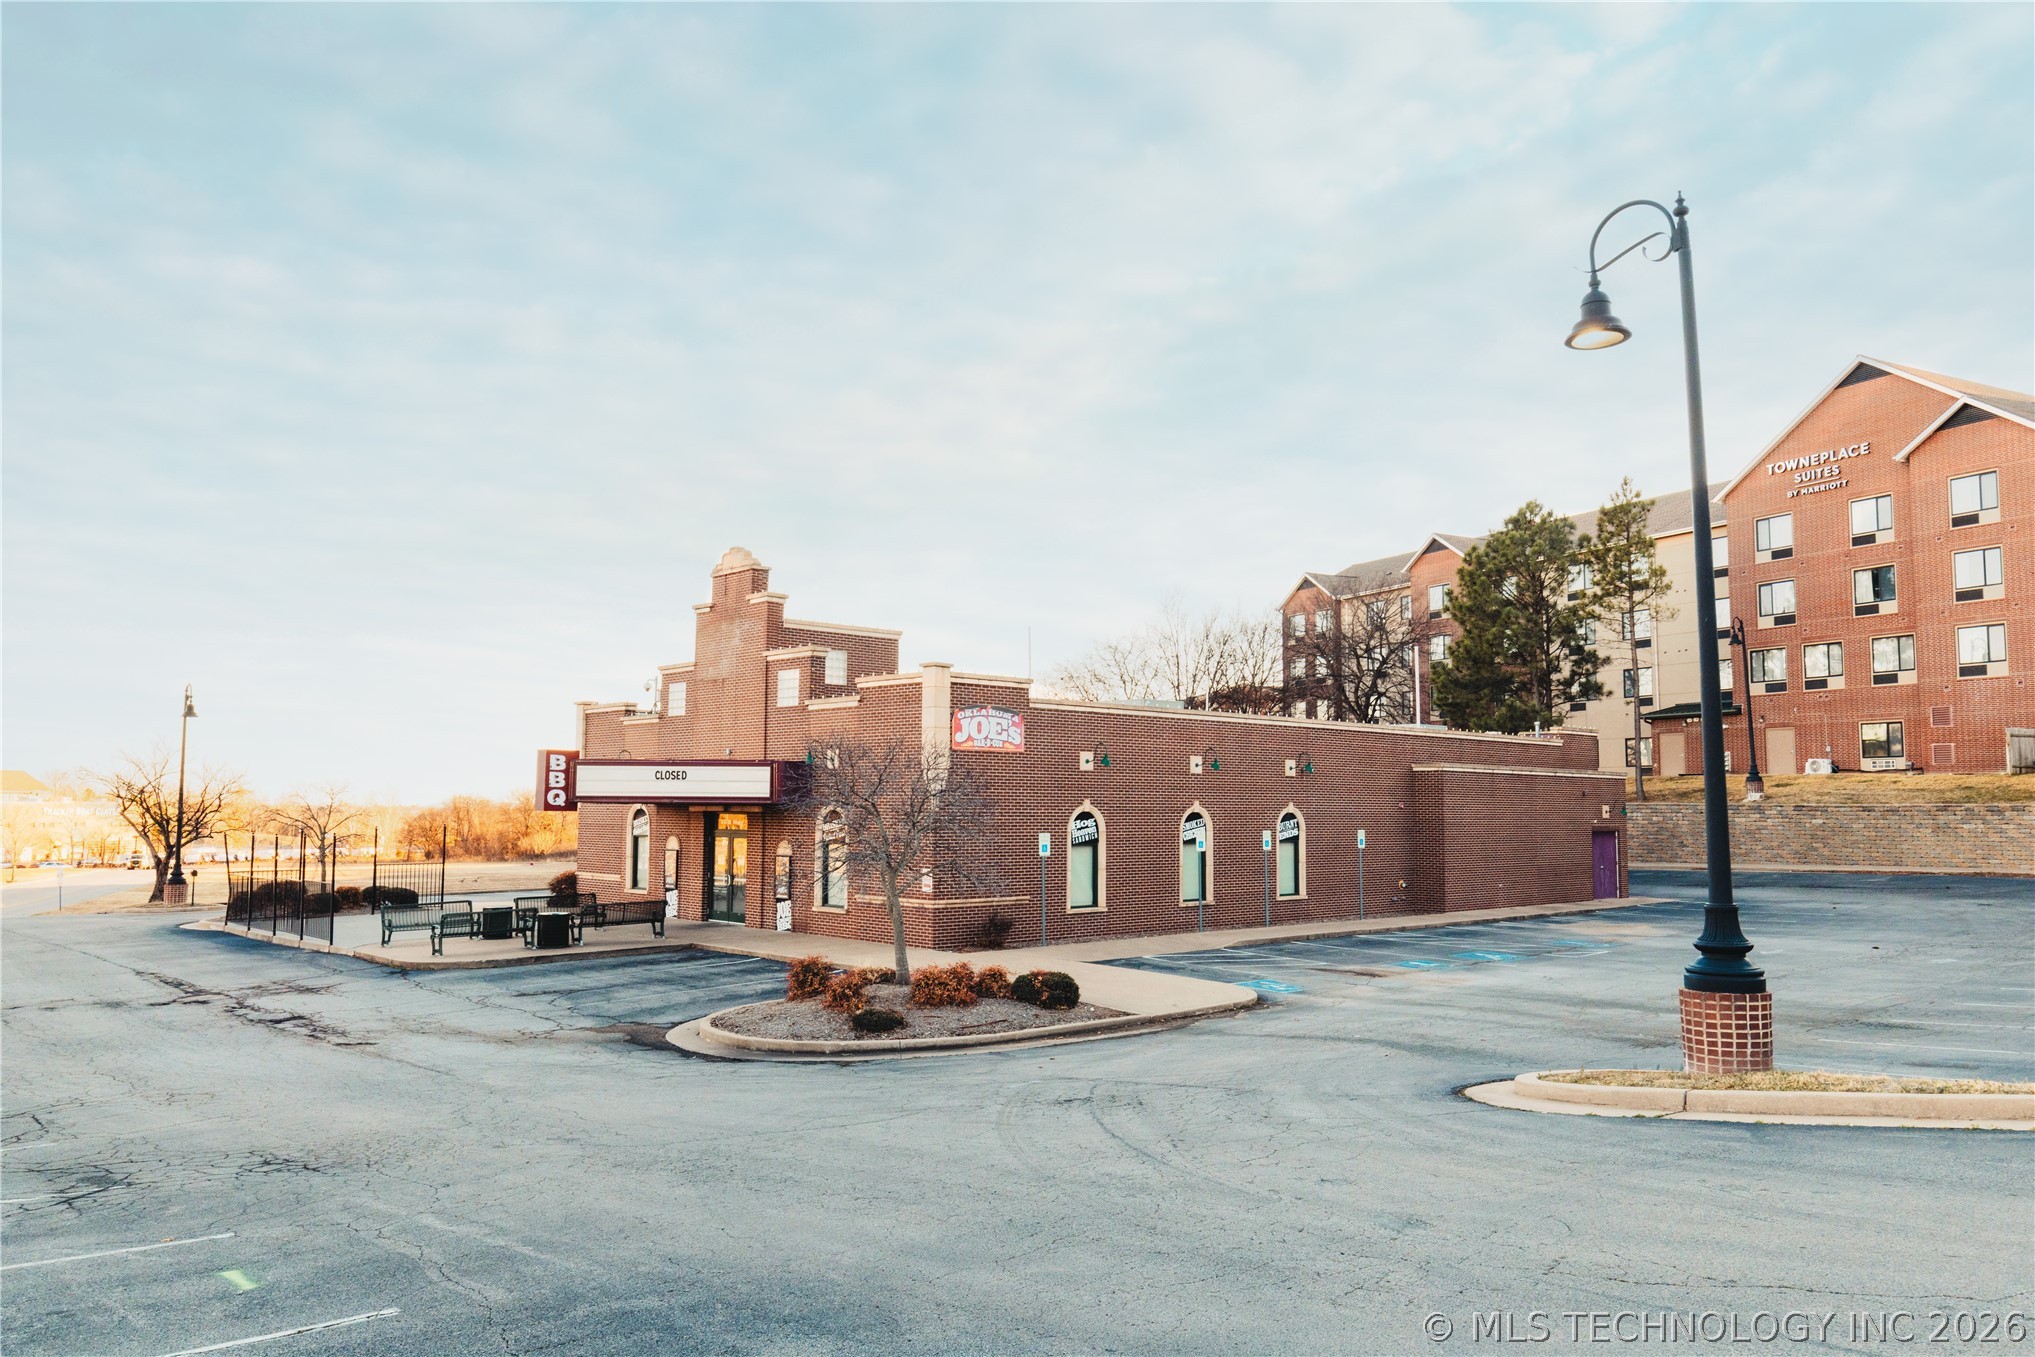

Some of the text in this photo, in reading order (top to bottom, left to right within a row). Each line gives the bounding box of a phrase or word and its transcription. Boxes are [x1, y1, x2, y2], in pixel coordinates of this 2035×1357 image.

[1766, 442, 1871, 475] TOWNEPLACE
[1794, 465, 1841, 483] SUITES
[1787, 479, 1849, 498] BY MARRIOTT
[957, 709, 1019, 723] OKLAHOMA
[955, 716, 1022, 745] JOE'S
[547, 754, 567, 807] BBQ
[654, 770, 688, 781] CLOSED
[1072, 818, 1096, 830] Hog
[1278, 819, 1298, 831] BURNT
[1279, 829, 1299, 841] ENDS
